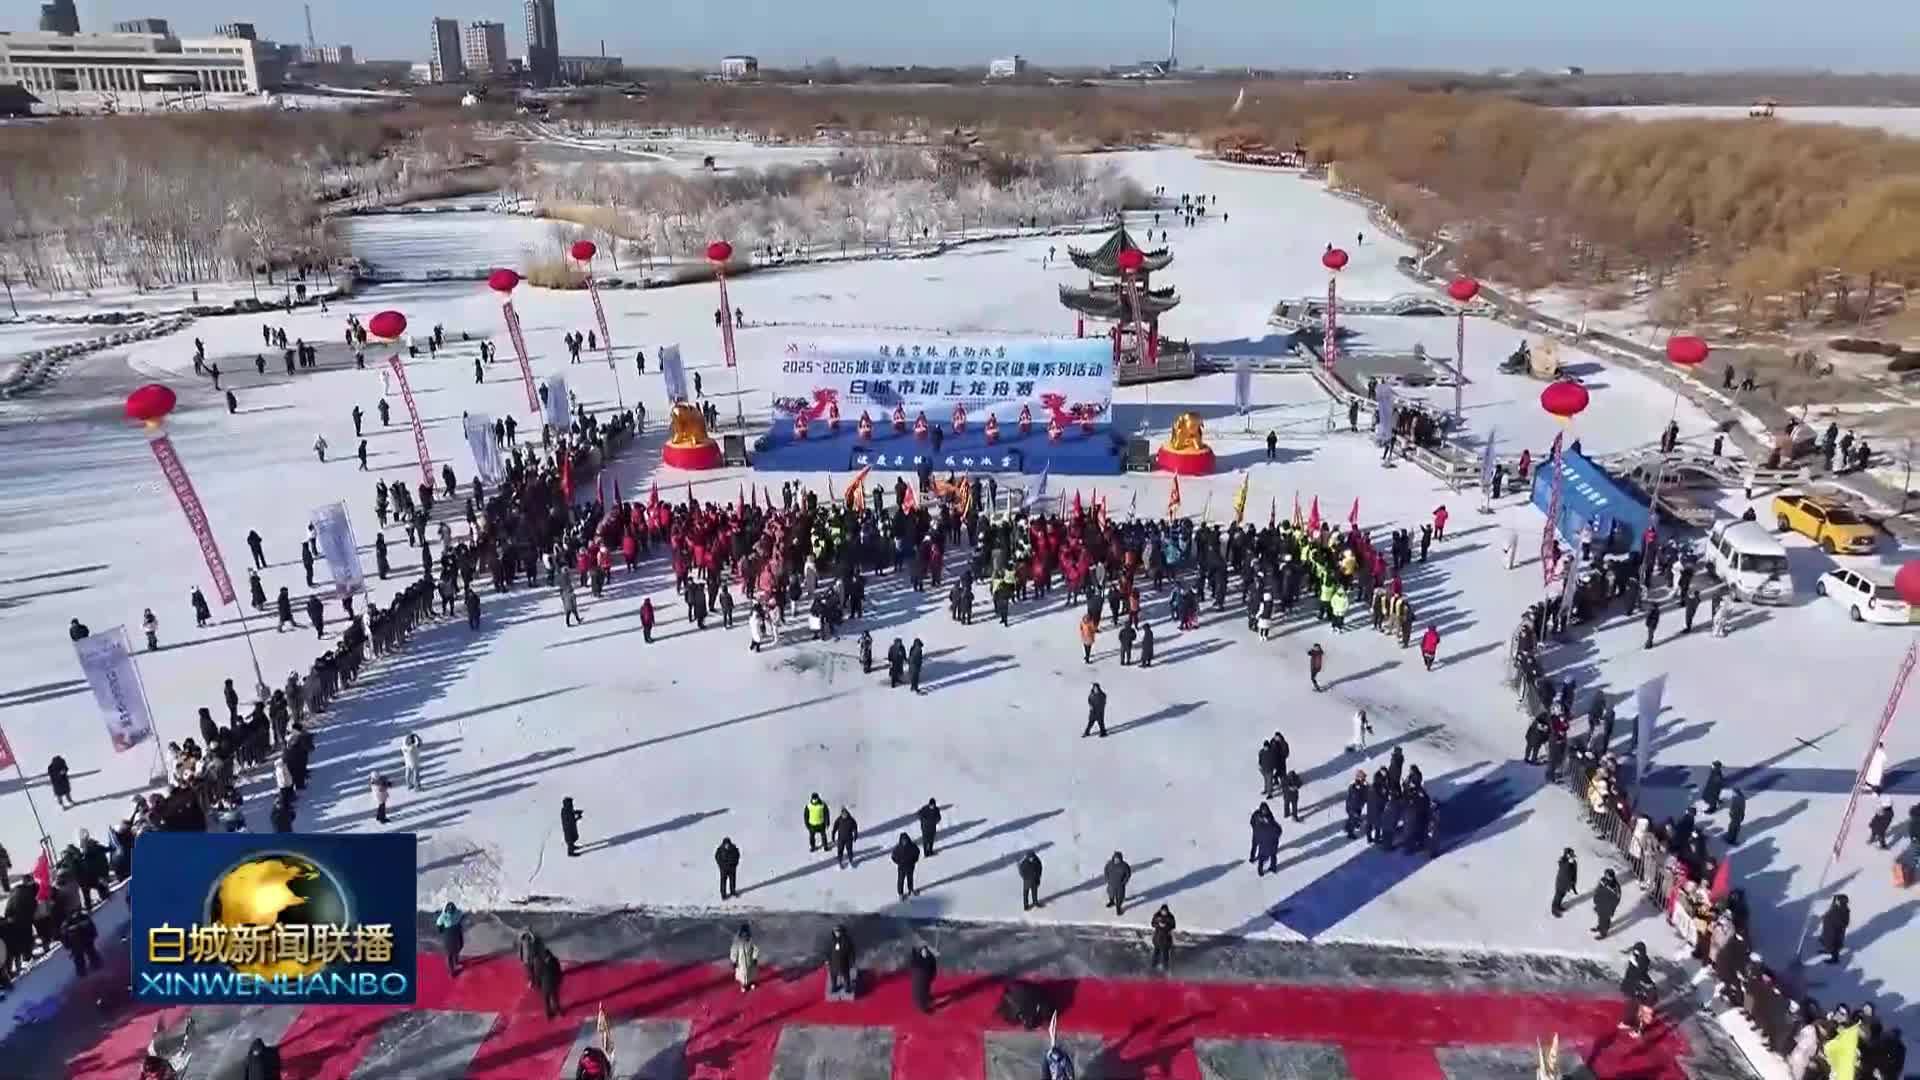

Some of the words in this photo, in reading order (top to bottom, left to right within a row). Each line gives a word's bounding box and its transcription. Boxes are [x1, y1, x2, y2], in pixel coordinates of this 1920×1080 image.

[850, 379, 1035, 397] 白城市冰上龙舟赛
